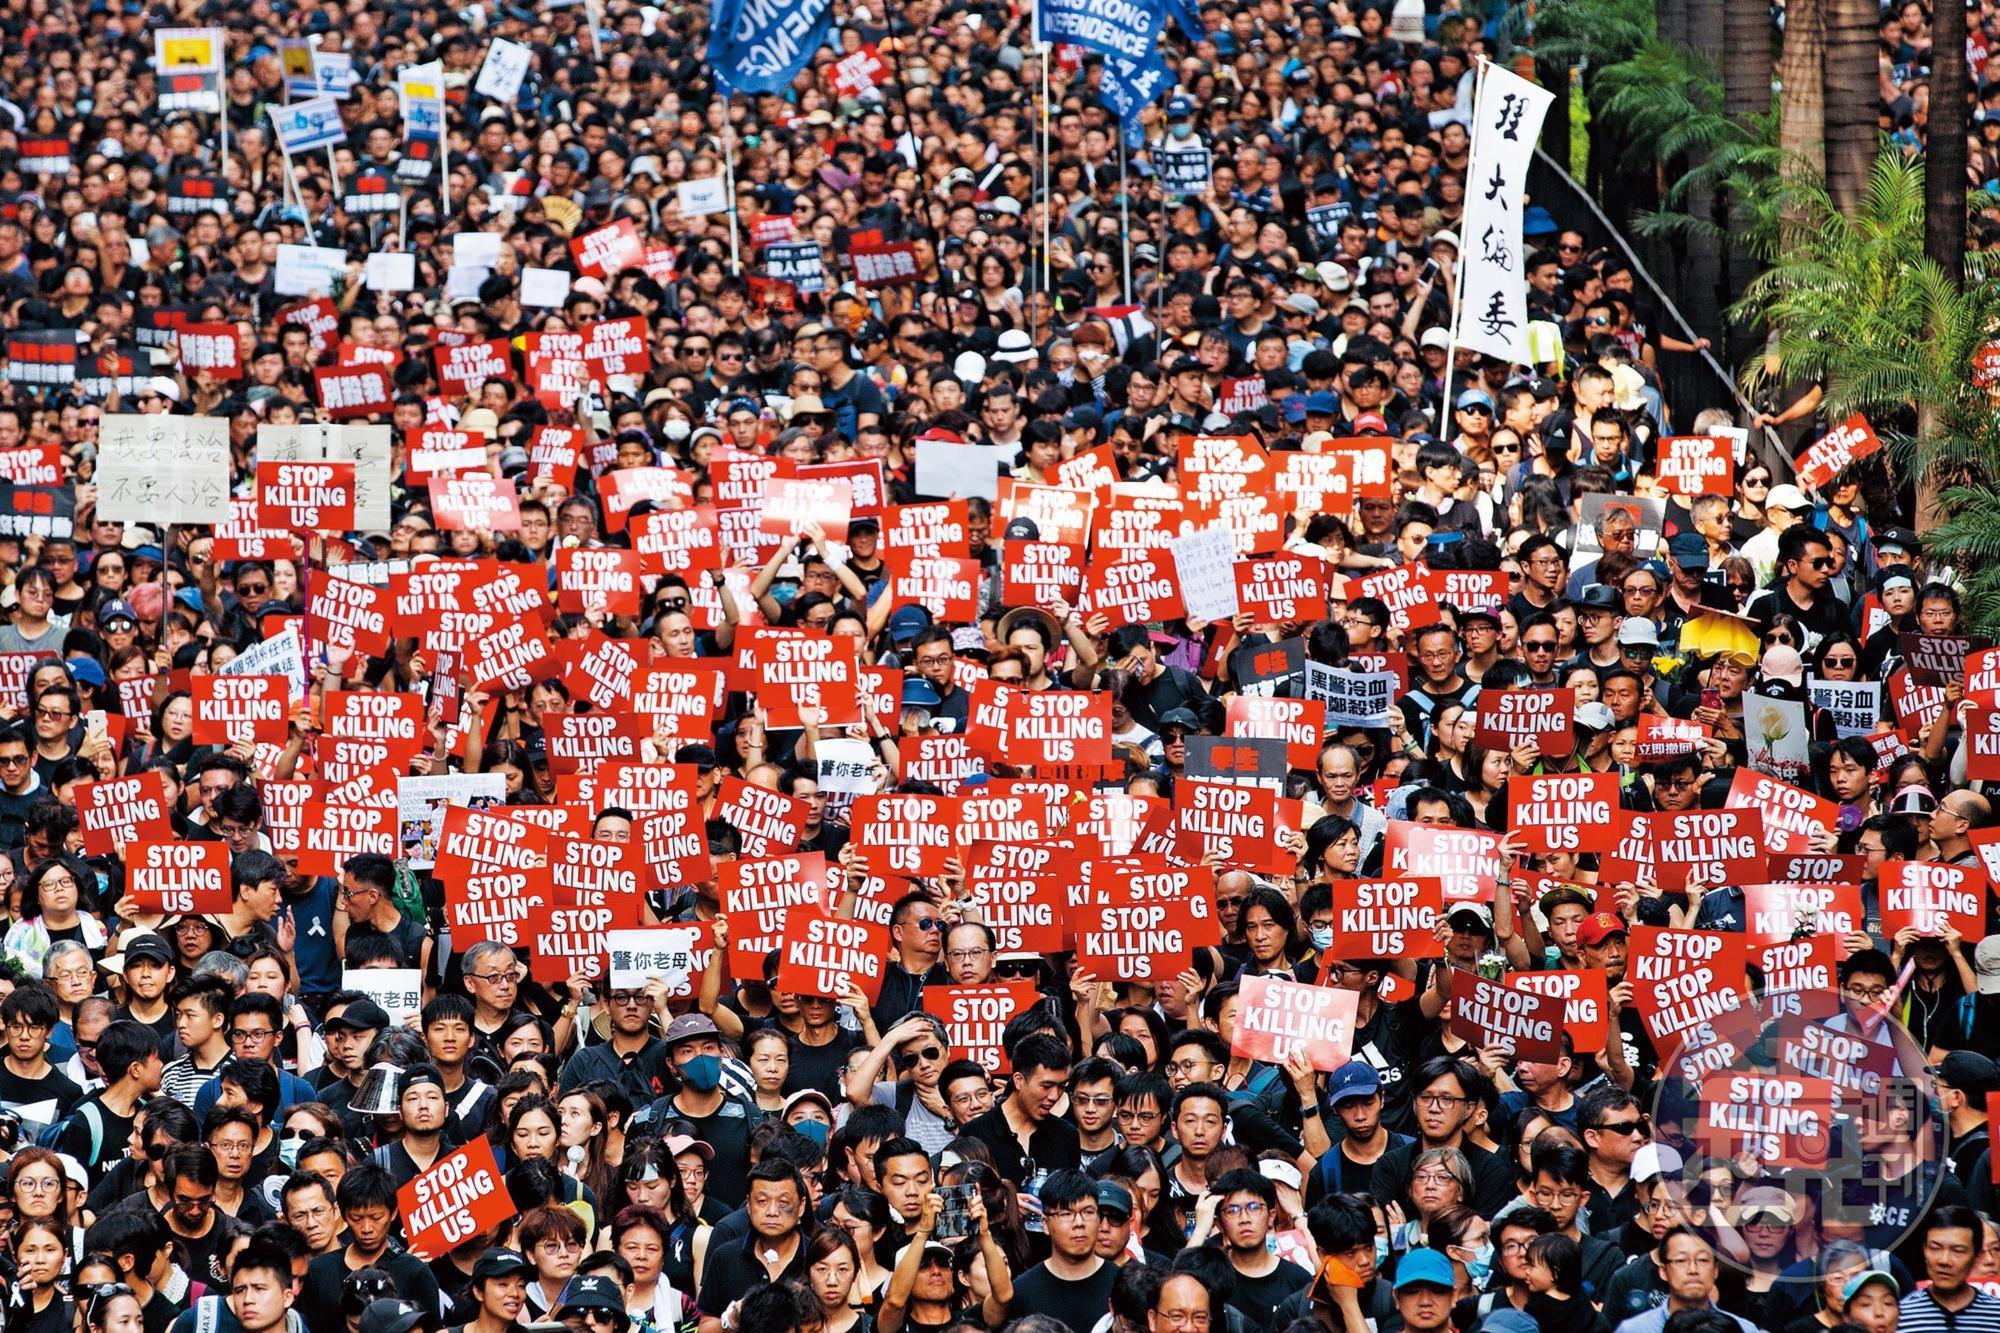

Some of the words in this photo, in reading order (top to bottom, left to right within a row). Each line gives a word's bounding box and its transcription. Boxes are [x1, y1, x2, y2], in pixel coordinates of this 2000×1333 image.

[583, 225, 620, 247] STOP
[592, 322, 631, 340] STOP
[450, 344, 493, 362] STOP
[539, 335, 583, 351] STOP
[584, 339, 642, 359] KILLING
[442, 358, 505, 380] KILLING
[602, 355, 625, 374] US
[113, 428, 223, 463] 我要法治
[1670, 440, 1713, 458] STOP
[1808, 422, 1849, 461] STOP
[278, 465, 334, 485] STOP
[1287, 455, 1336, 474] STOP
[1660, 458, 1726, 476] KILLING
[111, 477, 221, 509] 不要人治
[1678, 476, 1703, 494] US
[265, 487, 346, 508] KILLING
[291, 508, 319, 527] US
[647, 510, 698, 535] STOP
[900, 506, 950, 527] STOP
[1110, 511, 1161, 530] STOP
[637, 527, 713, 554] KILLING
[888, 523, 963, 547] KILLING
[571, 551, 622, 571] STOP
[663, 550, 691, 571] US
[1023, 543, 1071, 565] STOP
[910, 558, 961, 580] STOP
[1011, 563, 1079, 586] KILLING
[1104, 562, 1156, 587] STOP
[1252, 560, 1302, 583] STOP
[325, 578, 377, 607] STOP
[408, 573, 461, 595] STOP
[561, 570, 632, 592] KILLING
[897, 577, 971, 599] KILLING
[1242, 580, 1317, 604] KILLING
[1446, 574, 1492, 592] STOP
[1035, 584, 1061, 603] US
[1095, 580, 1173, 609] KILLING
[311, 595, 384, 635] KILLING
[1123, 601, 1151, 623] US
[1269, 601, 1296, 620] US
[478, 623, 525, 660] STOP
[776, 639, 833, 661] STOP
[1919, 638, 1970, 656] STOP
[473, 642, 546, 684] KILLING
[763, 661, 847, 684] KILLING
[213, 679, 268, 700] STOP
[646, 672, 697, 693] STOP
[1311, 670, 1388, 697] 黑警冷血
[200, 699, 282, 720] KILLING
[346, 695, 402, 717] STOP
[633, 692, 707, 716] KILLING
[1030, 696, 1089, 717] STOP
[1499, 693, 1555, 713] STOP
[1806, 688, 1873, 709] 警冷血
[332, 716, 415, 739] KILLING
[563, 716, 616, 737] STOP
[1015, 717, 1103, 740] KILLING
[1484, 713, 1565, 732] KILLING
[336, 742, 388, 765] STOP
[552, 736, 633, 757] KILLING
[1043, 740, 1075, 762] US
[1638, 742, 1692, 755] 立即撤回
[618, 766, 676, 788] STOP
[92, 780, 142, 807] STOP
[263, 784, 312, 806] STOP
[1194, 786, 1251, 812] STOP
[1532, 778, 1594, 801] STOP
[1755, 779, 1817, 813] STOP
[739, 786, 792, 818] STOP
[877, 799, 936, 822] STOP
[963, 799, 1023, 822] STOP
[1517, 801, 1610, 825] KILLING
[84, 800, 161, 830] KILLING
[322, 808, 382, 831] STOP
[720, 802, 796, 847] KILLING
[1181, 808, 1264, 838] KILLING
[1674, 813, 1737, 838] STOP
[466, 813, 526, 844] STOP
[643, 813, 686, 841] STOP
[863, 823, 949, 847] KILLING
[1546, 825, 1579, 849] US
[308, 829, 393, 855] KILLING
[1660, 836, 1756, 863] KILLING
[147, 845, 206, 867] STOP
[565, 842, 622, 868] STOP
[889, 846, 922, 869] US
[133, 868, 222, 891] KILLING
[553, 863, 636, 893] KILLING
[655, 862, 683, 885] US
[739, 858, 801, 888] STOP
[1787, 858, 1844, 880] STOP
[1902, 865, 1964, 890] STOP
[467, 874, 526, 900] STOP
[726, 881, 819, 913] KILLING
[974, 880, 1036, 904] STOP
[1129, 872, 1189, 900] STOP
[1357, 882, 1419, 906] STOP
[161, 891, 194, 912] US
[1888, 889, 1978, 916] KILLING
[550, 909, 613, 933] STOP
[1101, 906, 1165, 931] STOP
[1342, 907, 1435, 931] KILLING
[485, 922, 518, 945] US
[808, 919, 868, 949] STOP
[1086, 930, 1183, 957] KILLING
[1372, 932, 1404, 956] US
[1655, 933, 1722, 959] STOP
[613, 951, 688, 971] 警你老母
[789, 941, 878, 977] KILLING
[1117, 956, 1152, 979] US
[1762, 946, 1813, 972] STOP
[1264, 983, 1332, 1010] STOP
[1475, 982, 1539, 1017] STOP
[1654, 969, 1713, 1010] STOP
[952, 998, 1015, 1022] STOP
[1458, 999, 1553, 1041] KILLING
[1649, 984, 1741, 1039] KILLING
[1244, 1007, 1344, 1043] KILLING
[1802, 1025, 1869, 1064] STOP
[1729, 1078, 1803, 1107] STOP
[1709, 1103, 1818, 1137] KILLING
[414, 1153, 469, 1204] STOP
[407, 1169, 495, 1237] KILLING
[439, 1207, 479, 1245] US
